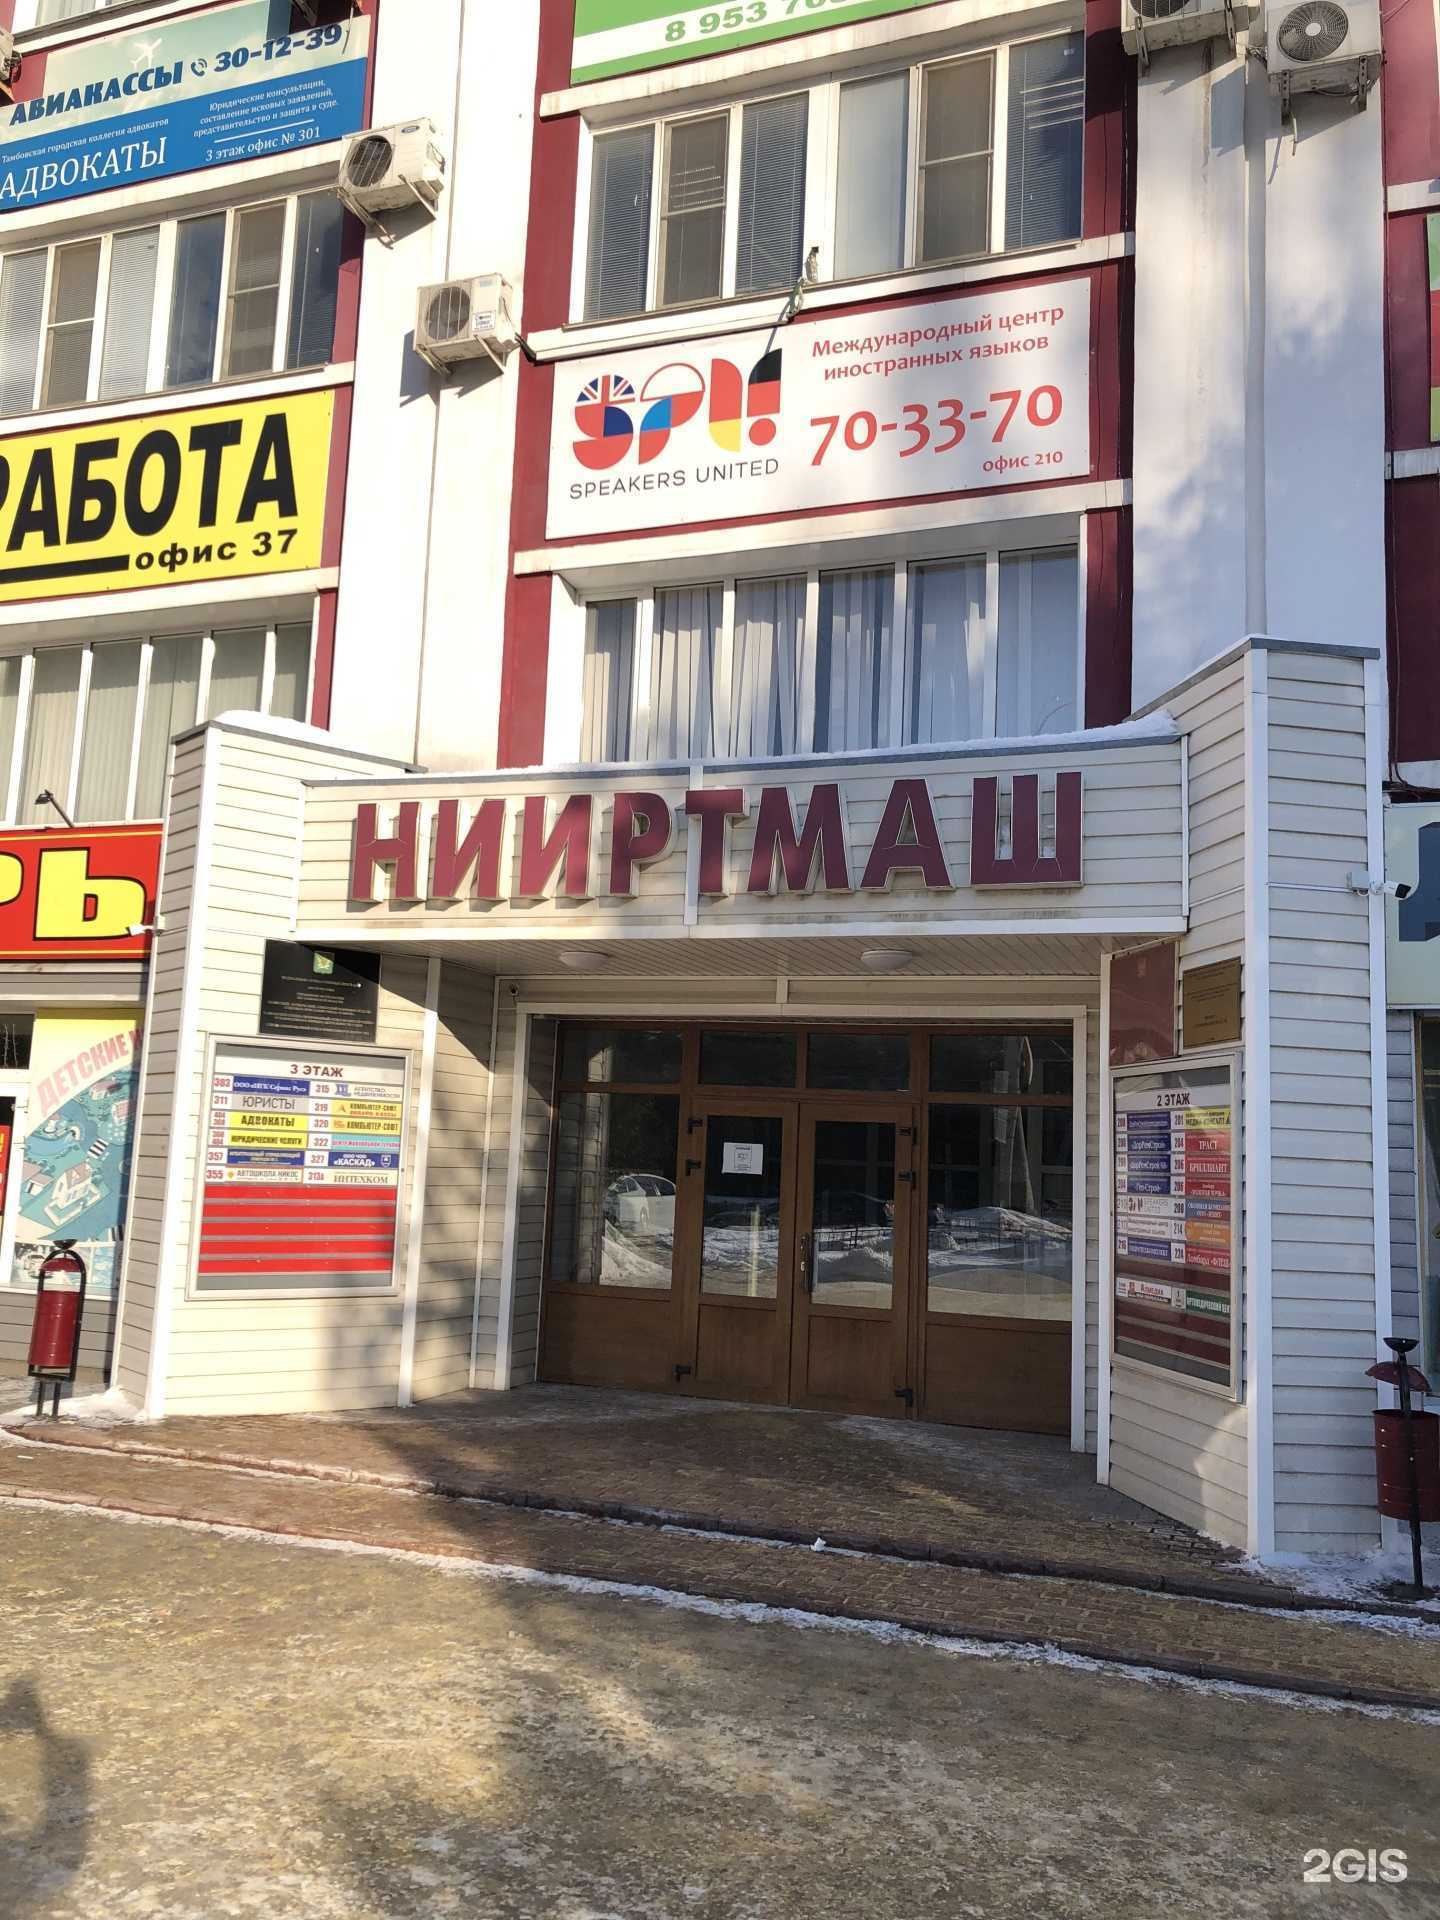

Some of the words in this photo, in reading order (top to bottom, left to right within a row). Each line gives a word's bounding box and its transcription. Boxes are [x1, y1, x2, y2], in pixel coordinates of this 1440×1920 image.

[664, 20, 686, 42] 8
[699, 1, 767, 34] 953
[9, 61, 183, 126] АВИАКАССЫ
[214, 23, 343, 72] 30-12-39
[193, 114, 271, 138] представительство
[279, 106, 310, 119] защита
[200, 108, 250, 125] составление
[250, 101, 286, 114] исковых
[208, 93, 265, 112] Юридические
[2, 147, 46, 163] Тамбовская
[47, 137, 86, 153] городская
[88, 128, 126, 143] коллегия
[127, 118, 169, 134] адвокатов
[205, 149, 213, 162] 3
[215, 145, 245, 160] этаж
[247, 138, 278, 154] офис
[281, 131, 296, 145] №
[298, 126, 321, 142] 301
[0, 136, 167, 202] АДВОКАТЫ
[812, 314, 992, 358] Международный
[998, 307, 1065, 332] центр
[823, 350, 963, 381] иностранных
[969, 336, 1049, 360] языков
[810, 384, 1063, 466] 70-33-70
[0, 412, 298, 553] АБОТА
[570, 469, 686, 500] SPEAKERS
[696, 457, 779, 484] UNITED
[982, 453, 1030, 474] офис
[1034, 451, 1063, 466] 210
[135, 541, 237, 573] офис
[252, 528, 298, 557] 37
[351, 771, 1085, 900] НИИРТМАШ
[37, 1033, 129, 1118] ДЕТСКИЕ
[290, 1064, 298, 1075] 3
[302, 1065, 343, 1078] ЭТАЖ
[213, 1095, 228, 1105] 311
[242, 1095, 296, 1110] ЮРИСТЫ
[1157, 1094, 1162, 1107] 2
[1164, 1092, 1191, 1106] ЭТАЖ
[241, 1115, 295, 1127] АДВОКАТЫ
[333, 1158, 376, 1168] «КАСКАД»
